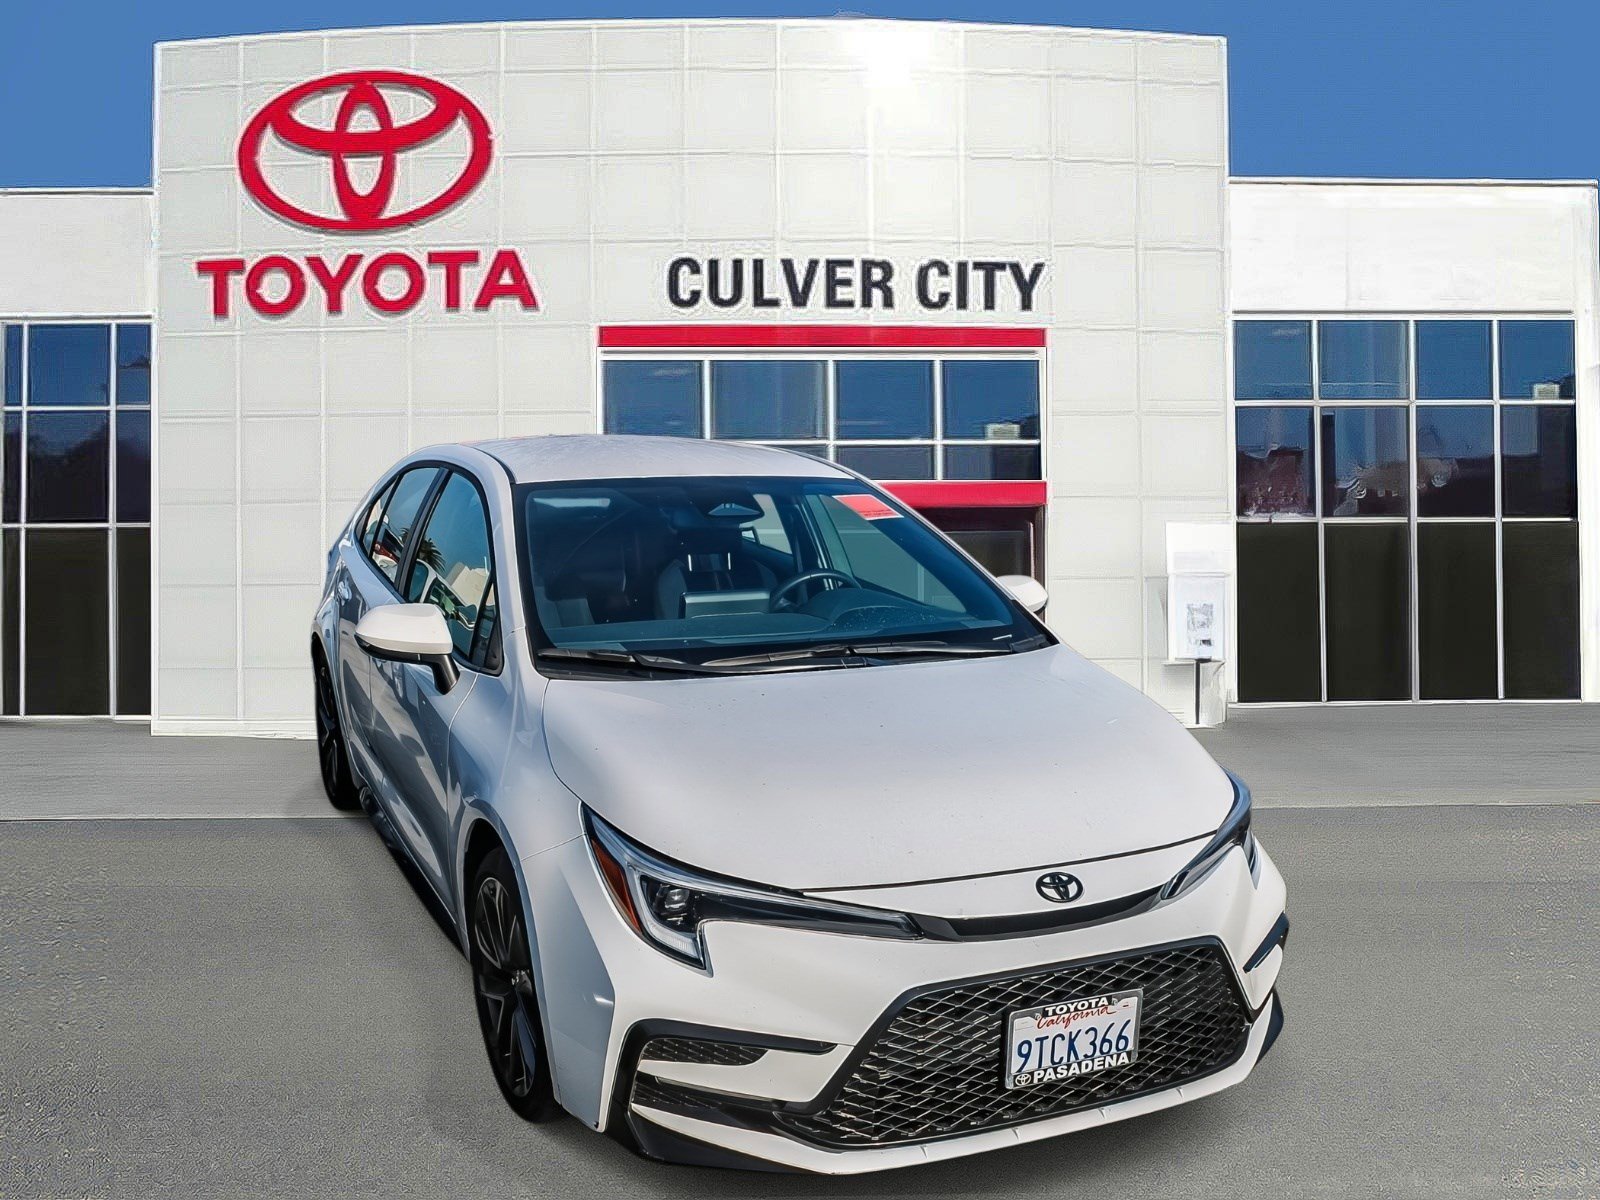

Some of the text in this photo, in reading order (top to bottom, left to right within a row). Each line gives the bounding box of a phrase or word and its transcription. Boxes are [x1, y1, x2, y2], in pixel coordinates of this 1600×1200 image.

[196, 249, 539, 319] TOYOTA
[667, 257, 1045, 311] CULVER CITY
[1036, 1005, 1117, 1029] California
[1044, 997, 1109, 1016] TOYOTA
[1016, 1019, 1131, 1073] 9TCK366
[1033, 1052, 1129, 1084] PASADENA
